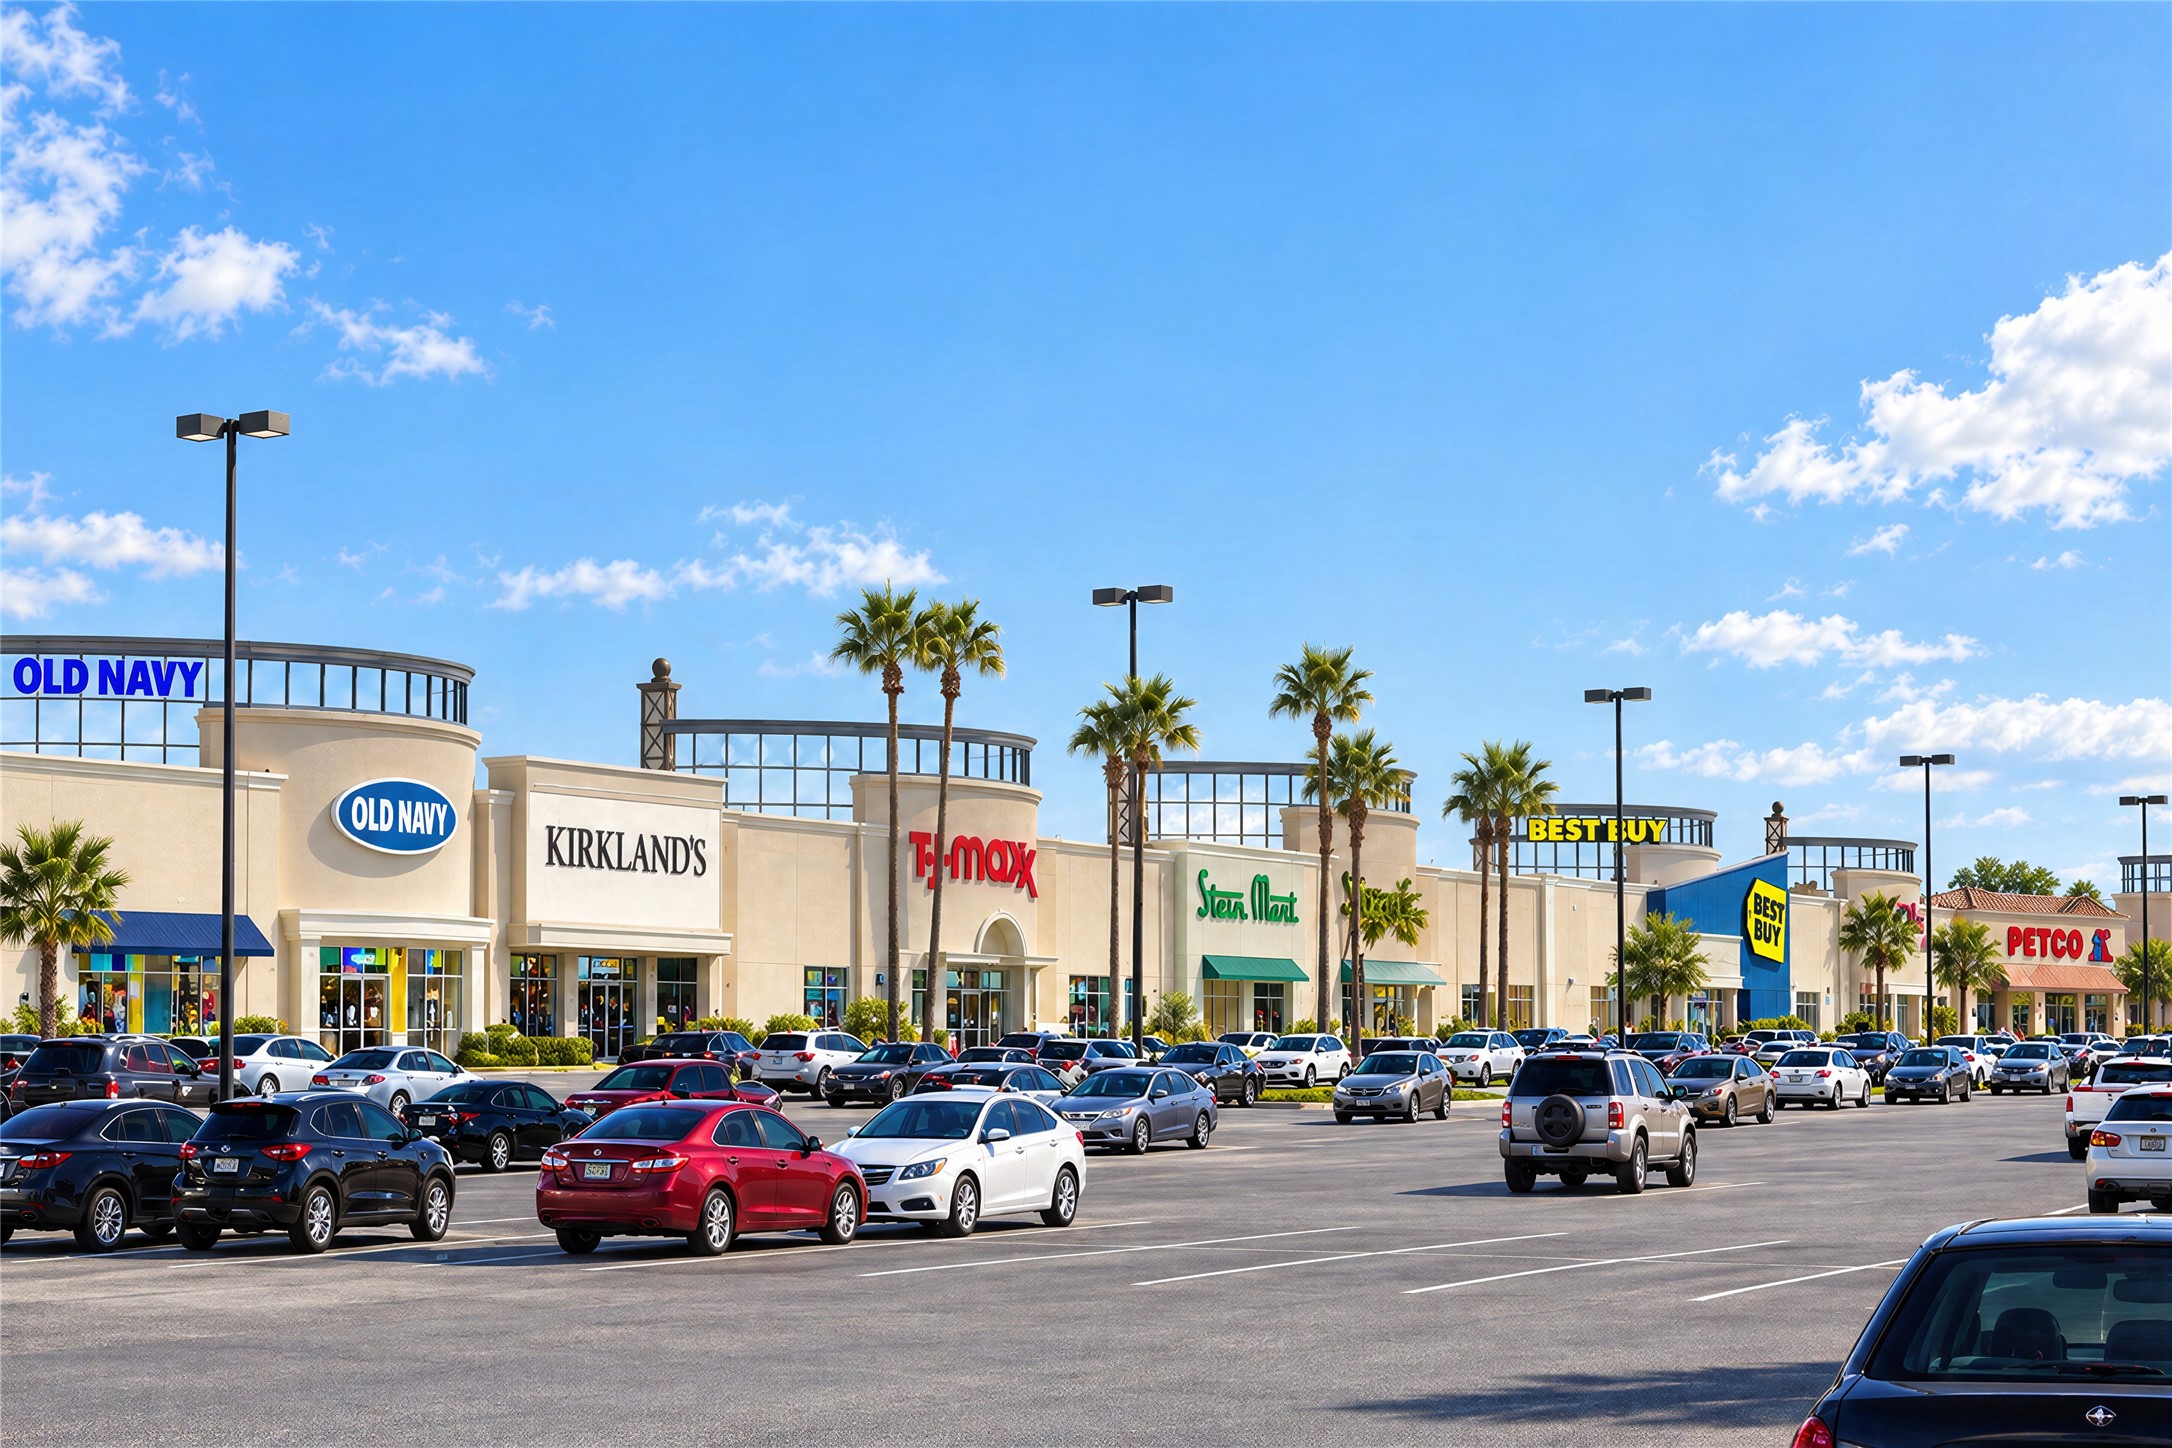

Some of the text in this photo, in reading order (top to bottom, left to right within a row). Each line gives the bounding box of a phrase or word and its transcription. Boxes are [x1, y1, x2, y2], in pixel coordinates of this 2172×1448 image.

[13, 657, 204, 698] OLD NAVY
[351, 796, 448, 837] OLD NAVY
[1528, 818, 1667, 843] BEST BUY
[546, 825, 707, 877] KIRKLAND'S
[1197, 868, 1249, 921] Stein
[1251, 873, 1300, 924] Mart
[1753, 892, 1785, 925] BEST
[1754, 917, 1782, 947] BUY
[2007, 926, 2084, 960] PETCO
